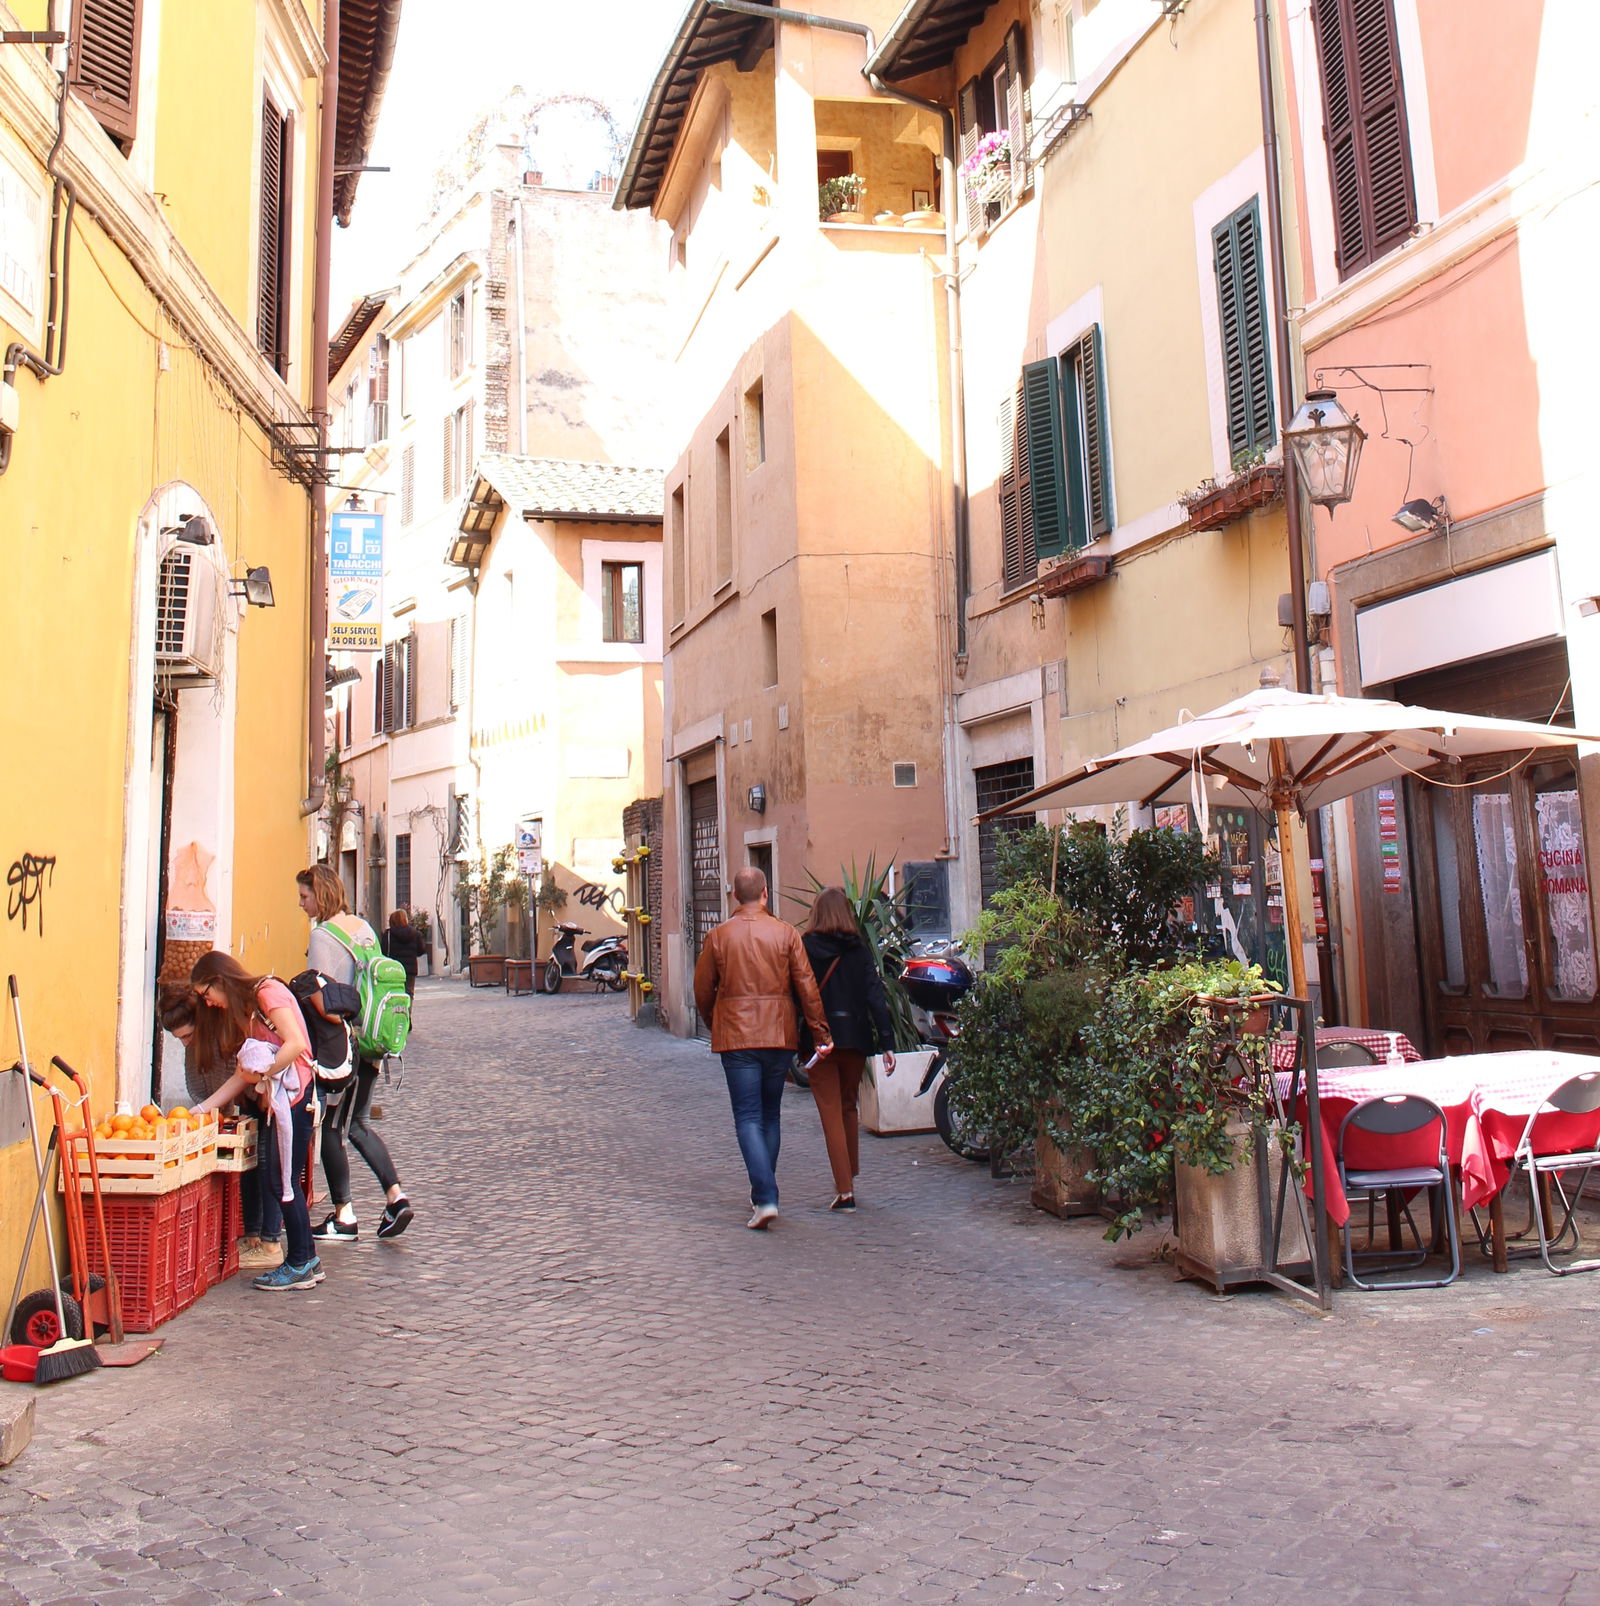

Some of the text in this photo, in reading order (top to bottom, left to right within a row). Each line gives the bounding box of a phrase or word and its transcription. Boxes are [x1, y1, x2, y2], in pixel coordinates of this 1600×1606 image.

[339, 518, 376, 554] T
[332, 559, 382, 569] TABACCHI
[333, 576, 378, 586] GIORNALI
[333, 626, 377, 635] SELF SERVICE
[331, 637, 378, 645] 24 ORE SU 24
[1538, 848, 1583, 868] CUCINA
[1540, 877, 1588, 895] ROMANA
